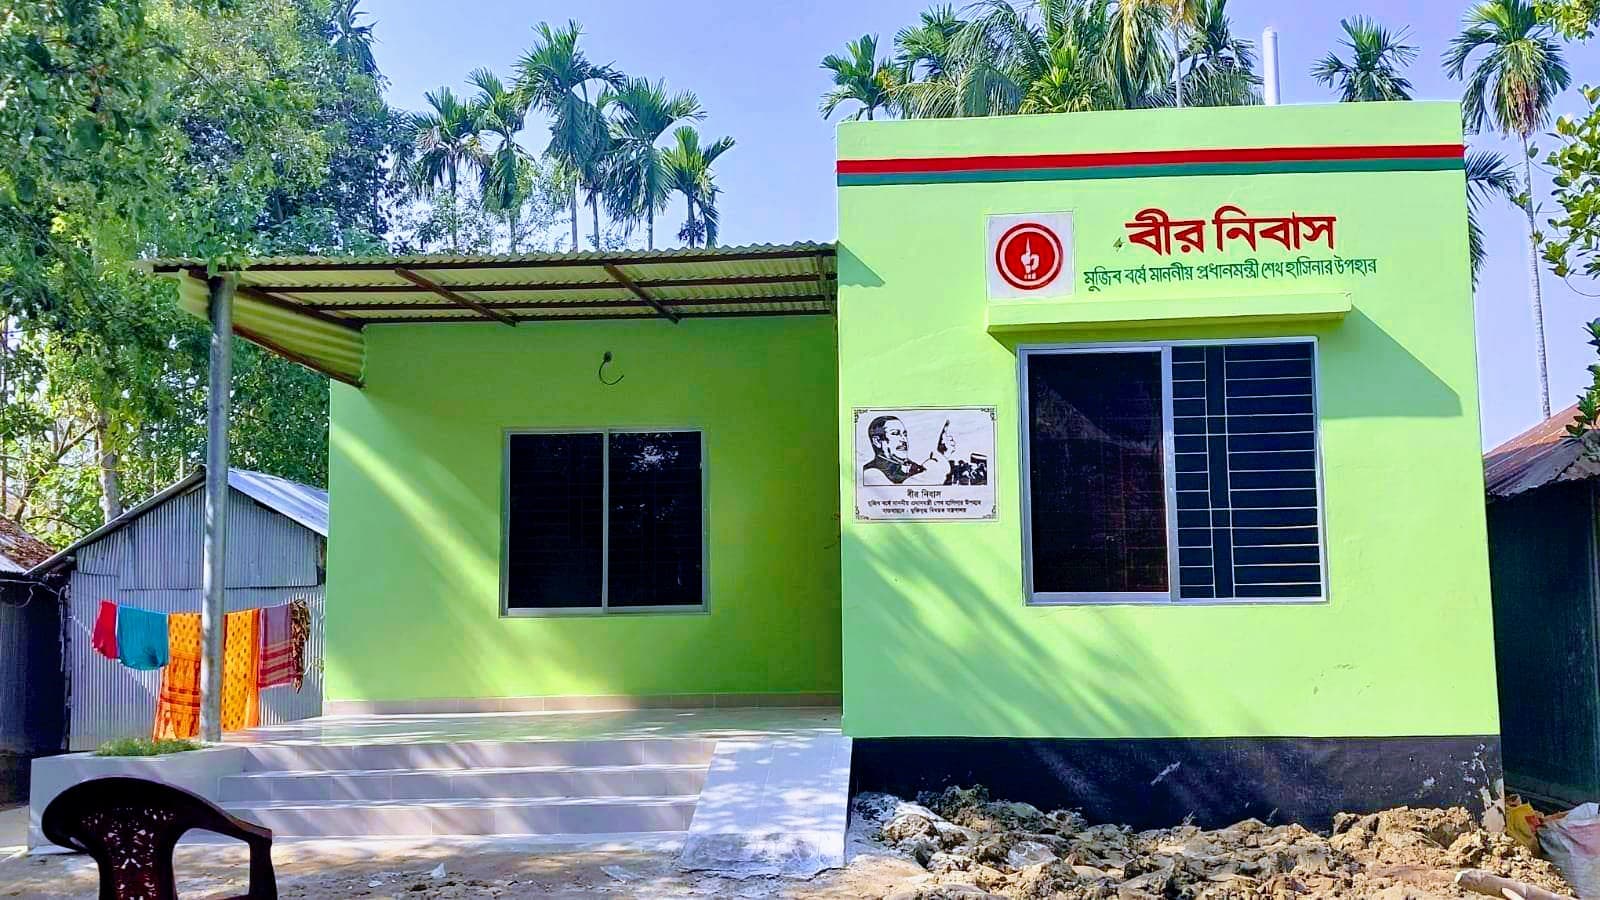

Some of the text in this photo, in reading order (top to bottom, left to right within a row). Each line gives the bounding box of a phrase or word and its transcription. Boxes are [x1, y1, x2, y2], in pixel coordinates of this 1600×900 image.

[1125, 205, 1337, 256] বীর নিবাস
[1083, 266, 1122, 292] মুজিব
[1124, 264, 1147, 285] বর্ষে
[1148, 261, 1193, 283] মাননীয়
[1196, 258, 1259, 280] প্রধানমন্ত্রী
[1285, 255, 1332, 279] হাসিনার
[1333, 254, 1378, 277] উপহার
